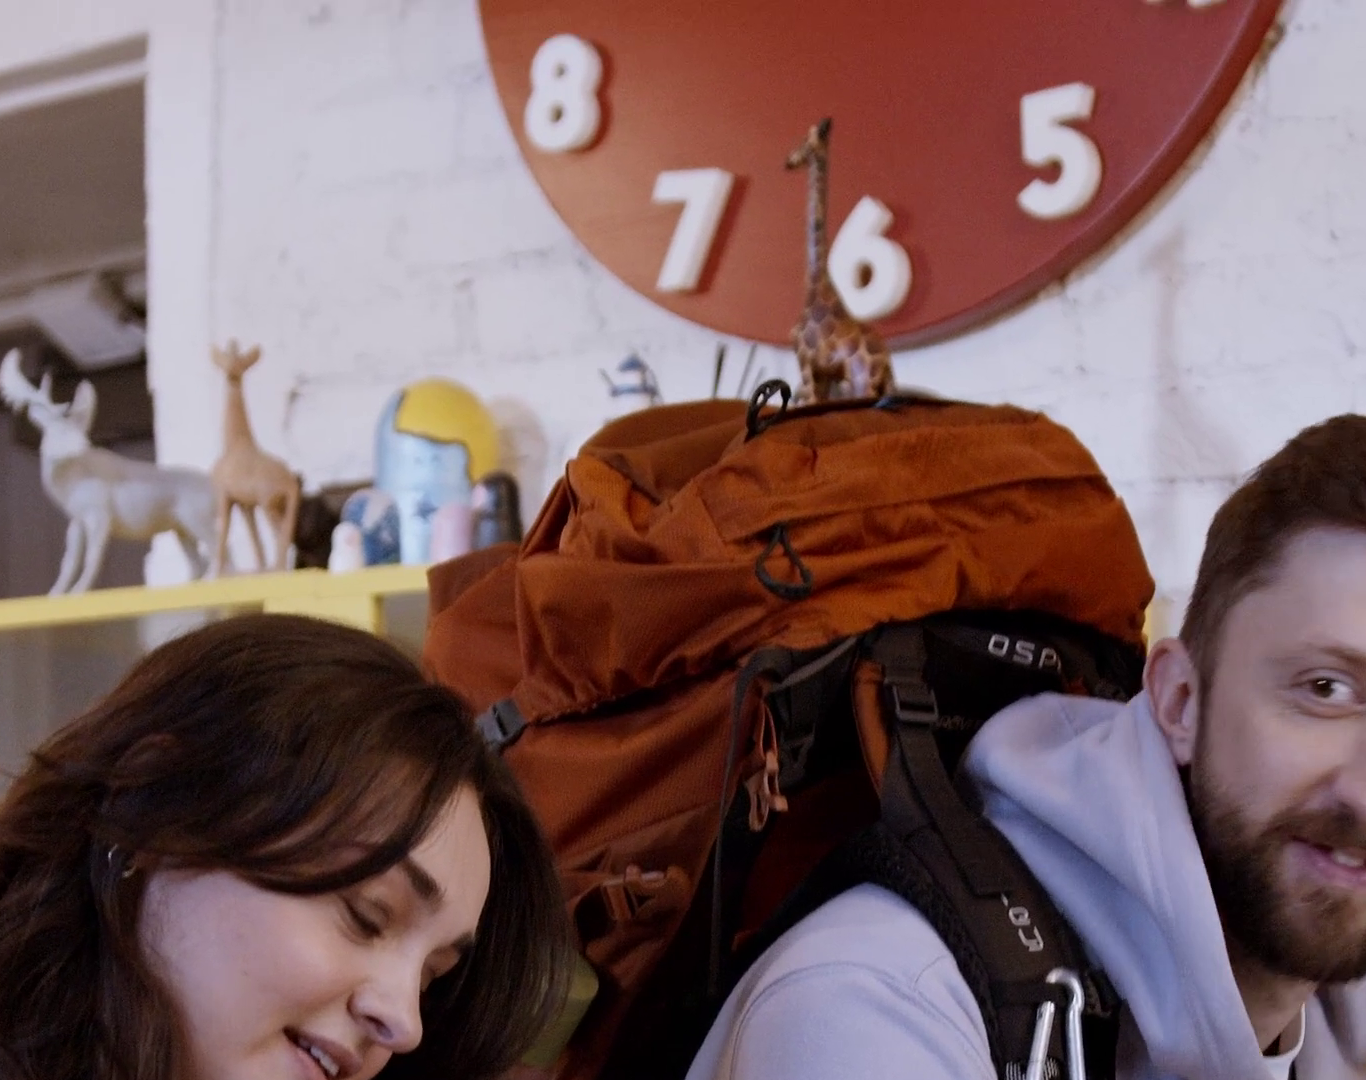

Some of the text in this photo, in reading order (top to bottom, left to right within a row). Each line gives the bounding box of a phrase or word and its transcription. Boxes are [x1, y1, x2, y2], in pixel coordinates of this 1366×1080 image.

[524, 33, 604, 153] 8
[1018, 83, 1100, 218] 5
[651, 167, 733, 292] 7
[827, 196, 910, 320] 6
